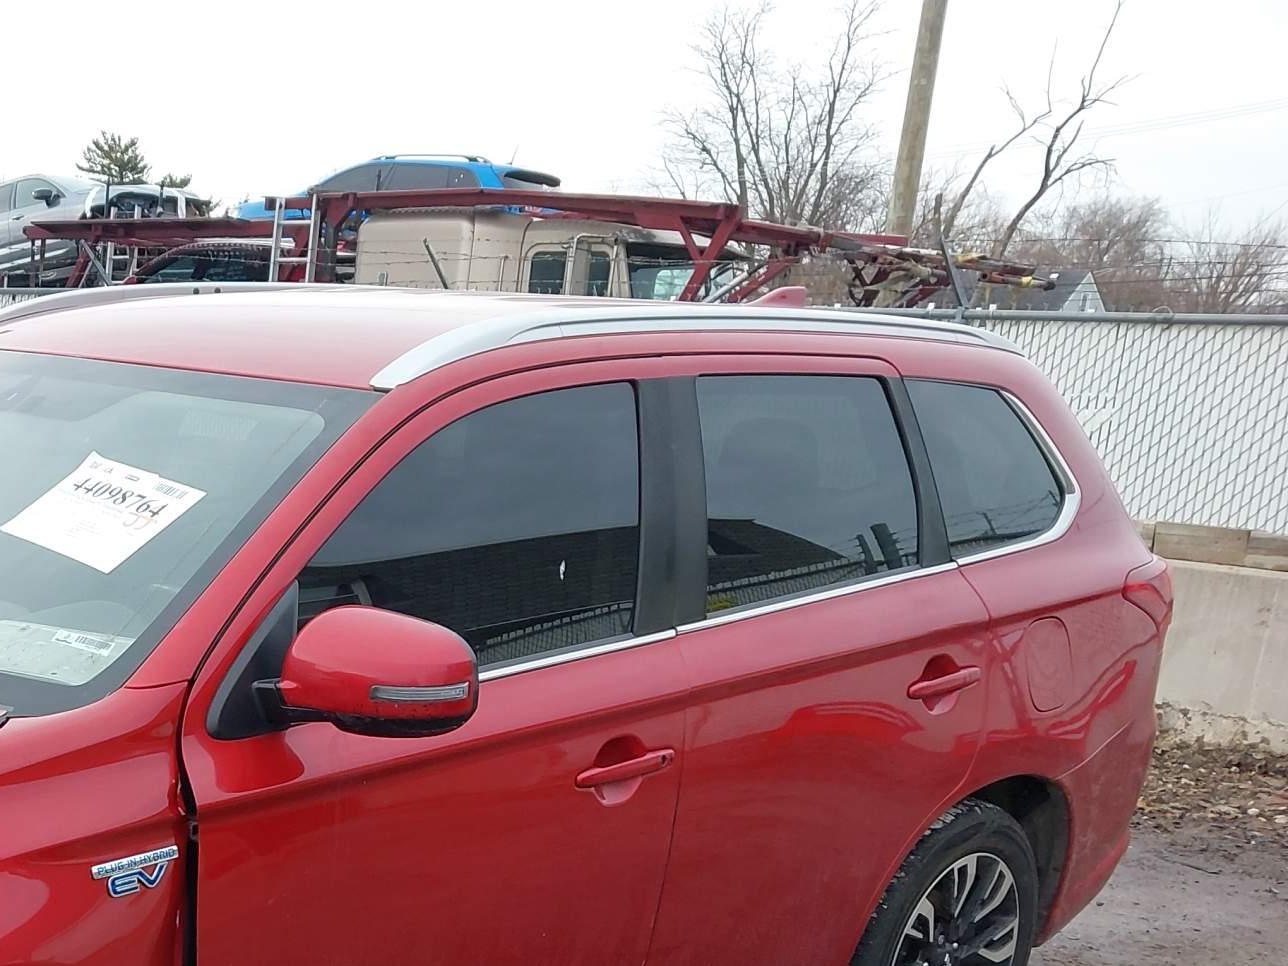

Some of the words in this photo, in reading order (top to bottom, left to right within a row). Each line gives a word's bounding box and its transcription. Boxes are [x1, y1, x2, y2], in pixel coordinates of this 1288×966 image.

[73, 477, 169, 518] 44098764
[139, 848, 175, 865] HYBRID
[108, 861, 169, 898] EV
